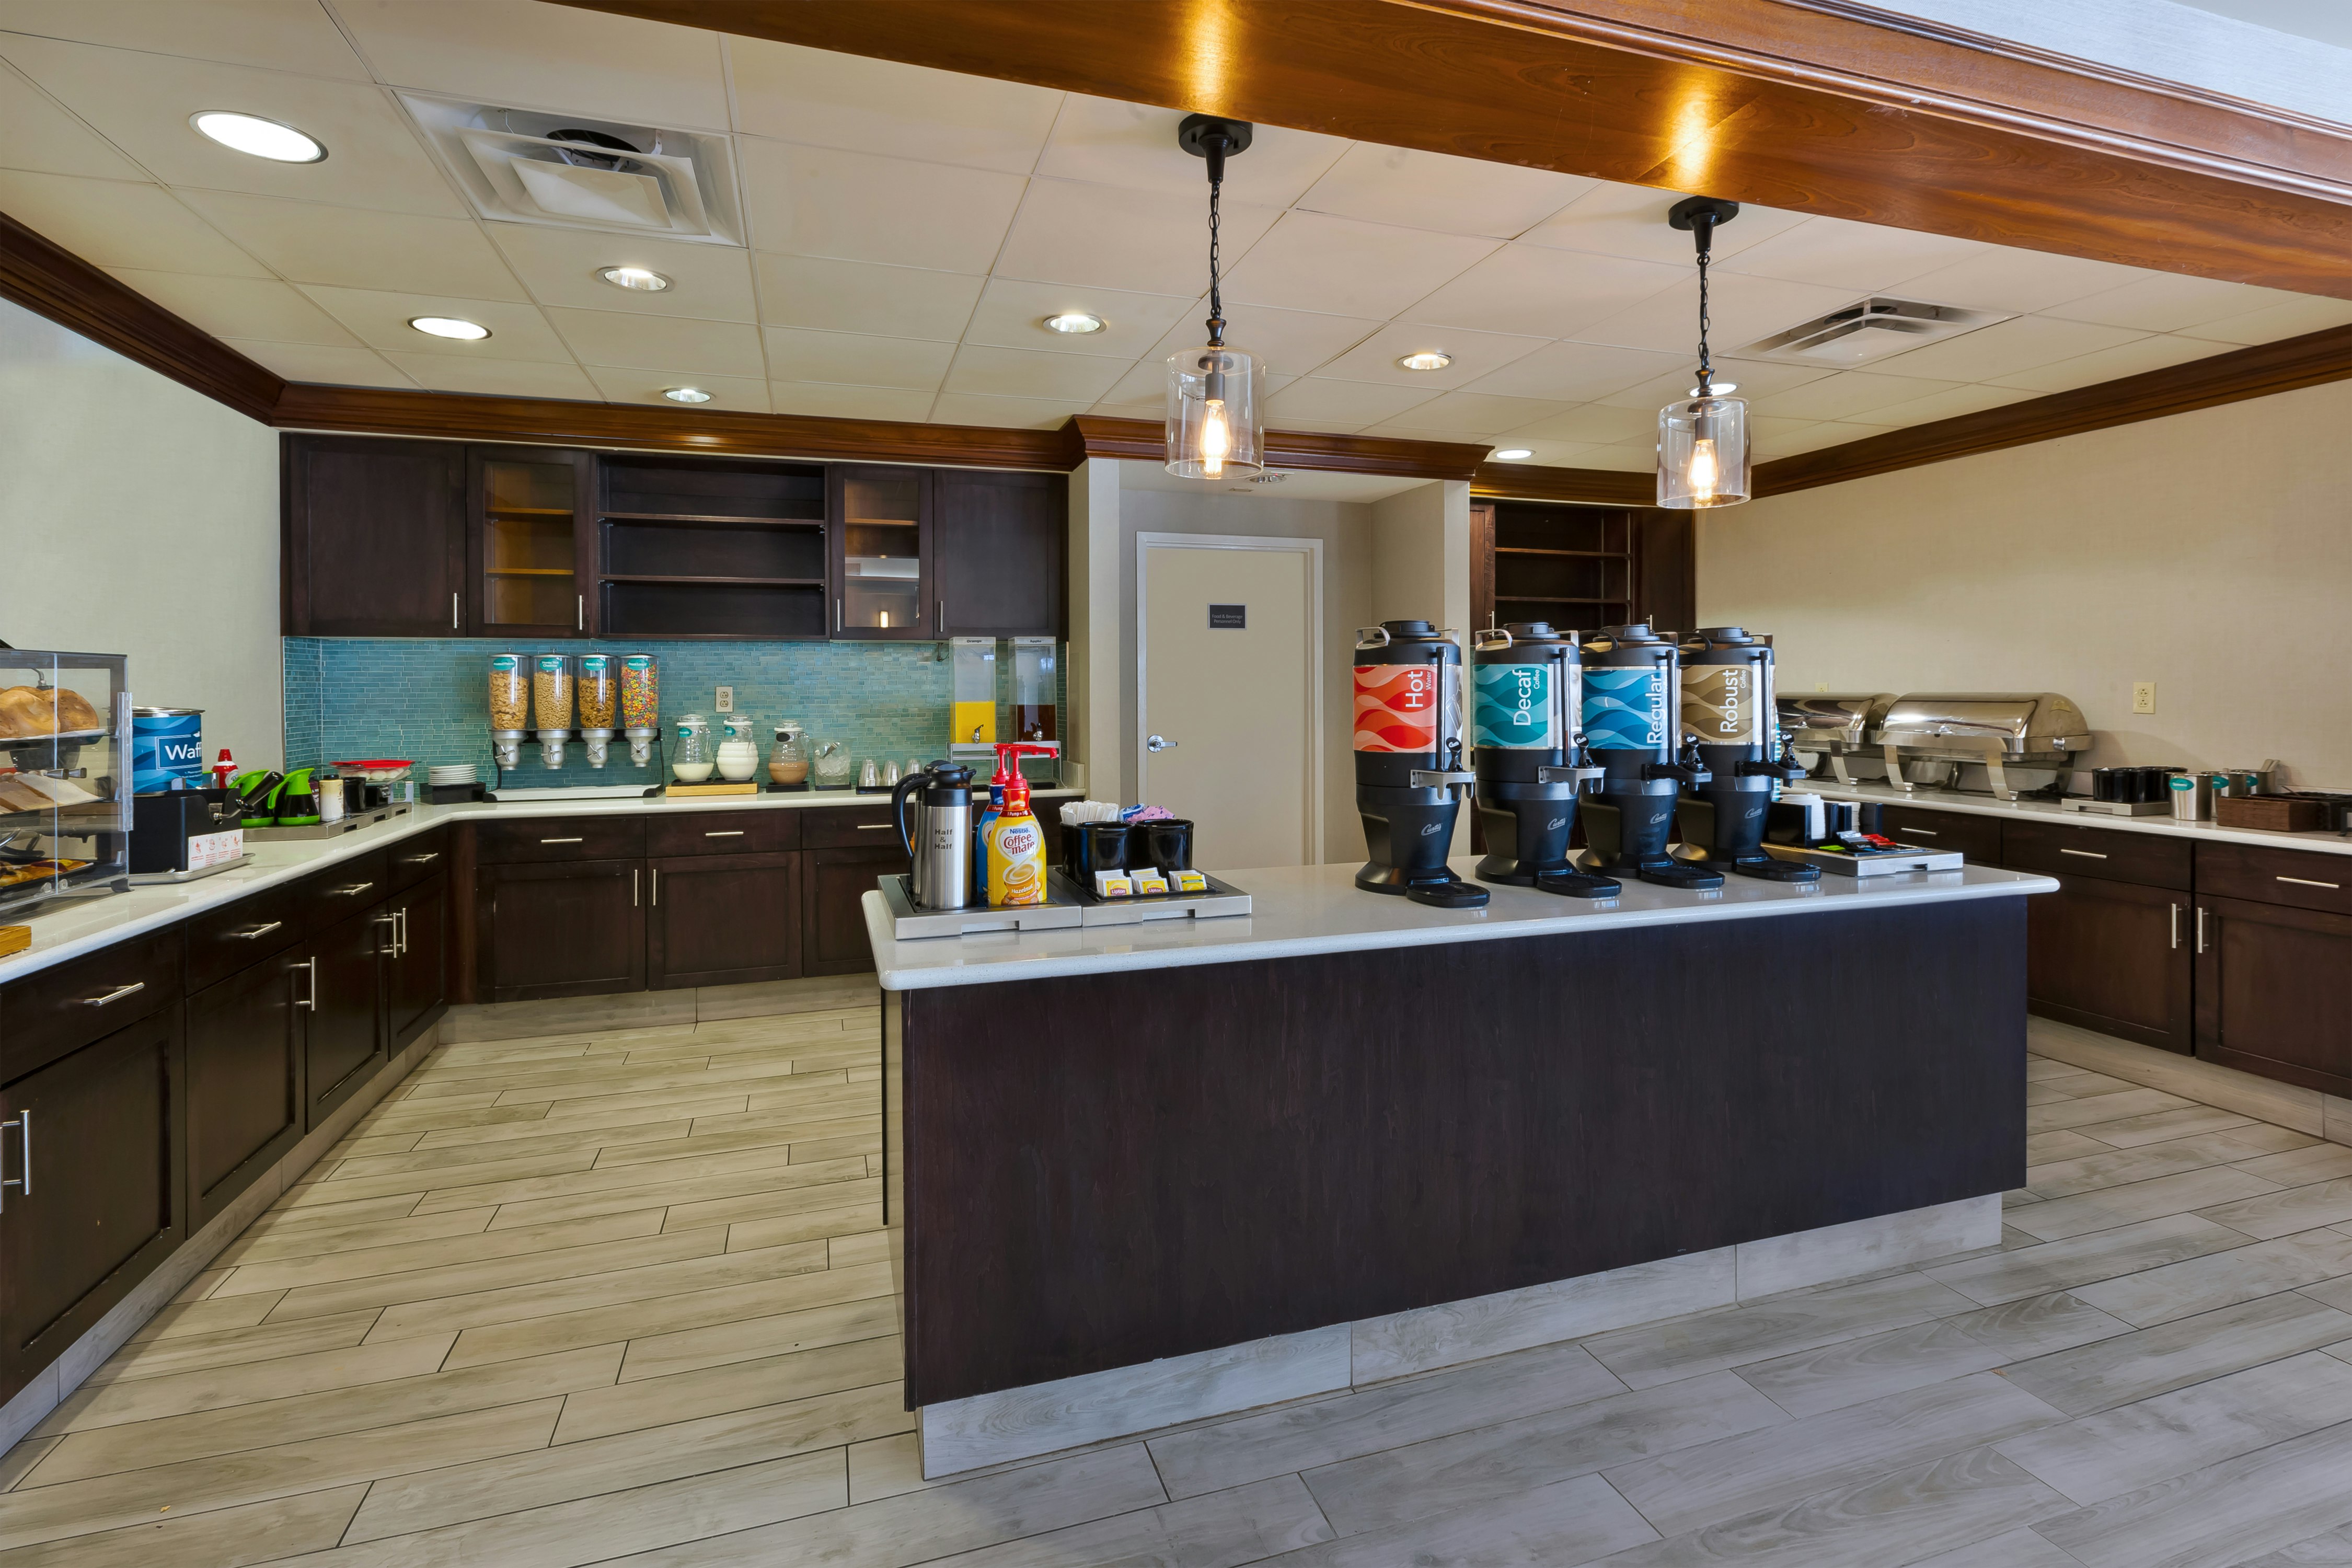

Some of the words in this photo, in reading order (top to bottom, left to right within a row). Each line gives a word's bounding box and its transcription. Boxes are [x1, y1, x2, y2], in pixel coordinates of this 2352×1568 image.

[1405, 671, 1423, 707] Hot
[1512, 670, 1531, 725] Decaf
[1645, 675, 1666, 743] Regular
[1719, 670, 1738, 732] Robust
[1012, 841, 1034, 855] mate
[1011, 883, 1033, 893] Hazelnut
